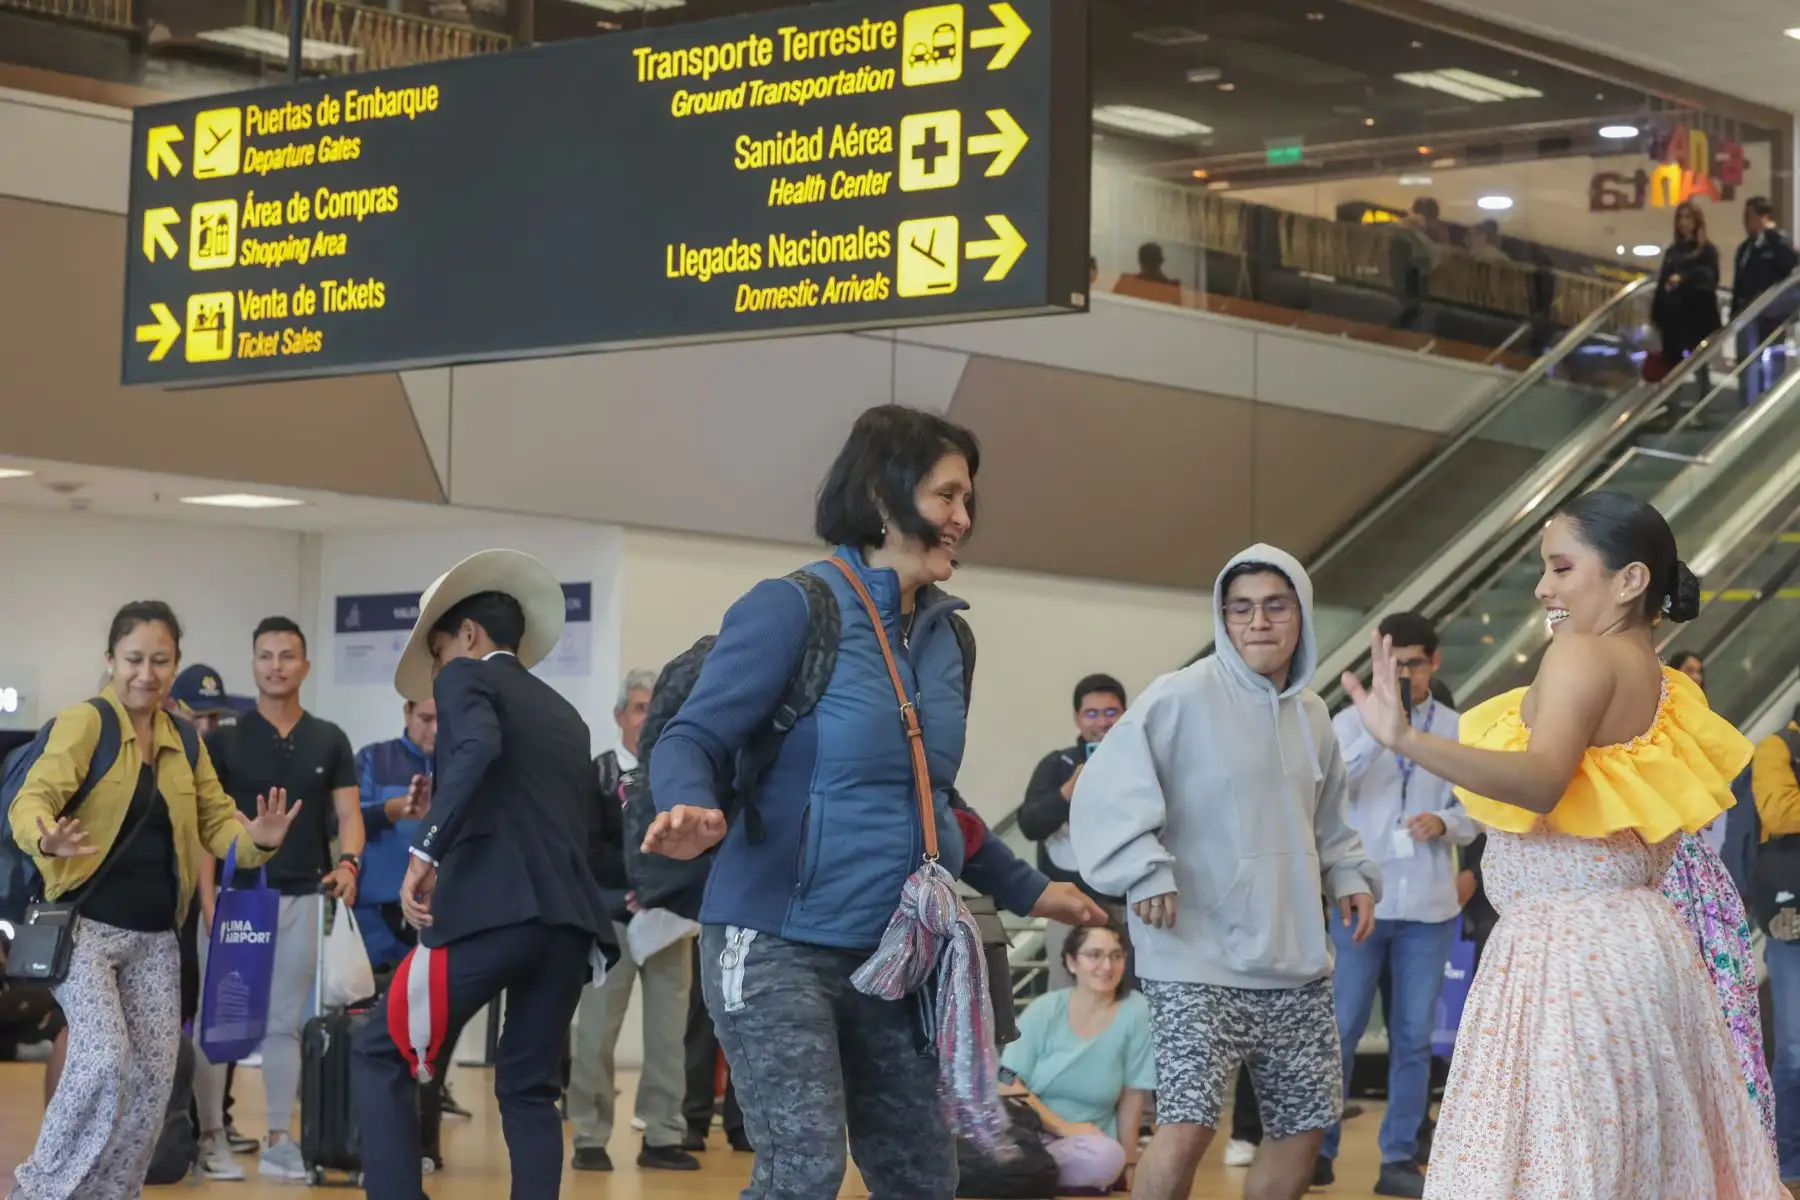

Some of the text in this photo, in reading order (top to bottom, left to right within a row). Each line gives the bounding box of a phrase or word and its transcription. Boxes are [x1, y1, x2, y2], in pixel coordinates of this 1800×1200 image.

[632, 18, 897, 81] Transporte Terrestre
[246, 84, 440, 137] Puertas de Embarque
[671, 65, 896, 117] Ground Transportation
[243, 135, 361, 176] Departure Gates
[734, 122, 893, 170] Sanidad Aérea
[241, 185, 399, 229] Área de Compras
[768, 169, 892, 206] Health Center
[239, 230, 347, 268] Shopping Area
[666, 225, 891, 282] Llegadas Nacionales
[238, 277, 386, 321] Venta de Tickets
[734, 272, 890, 313] Domestic Arrivals
[238, 327, 323, 359] Ticket Sales
[225, 931, 272, 943] AIRPORT
[226, 920, 253, 931] LIMA
